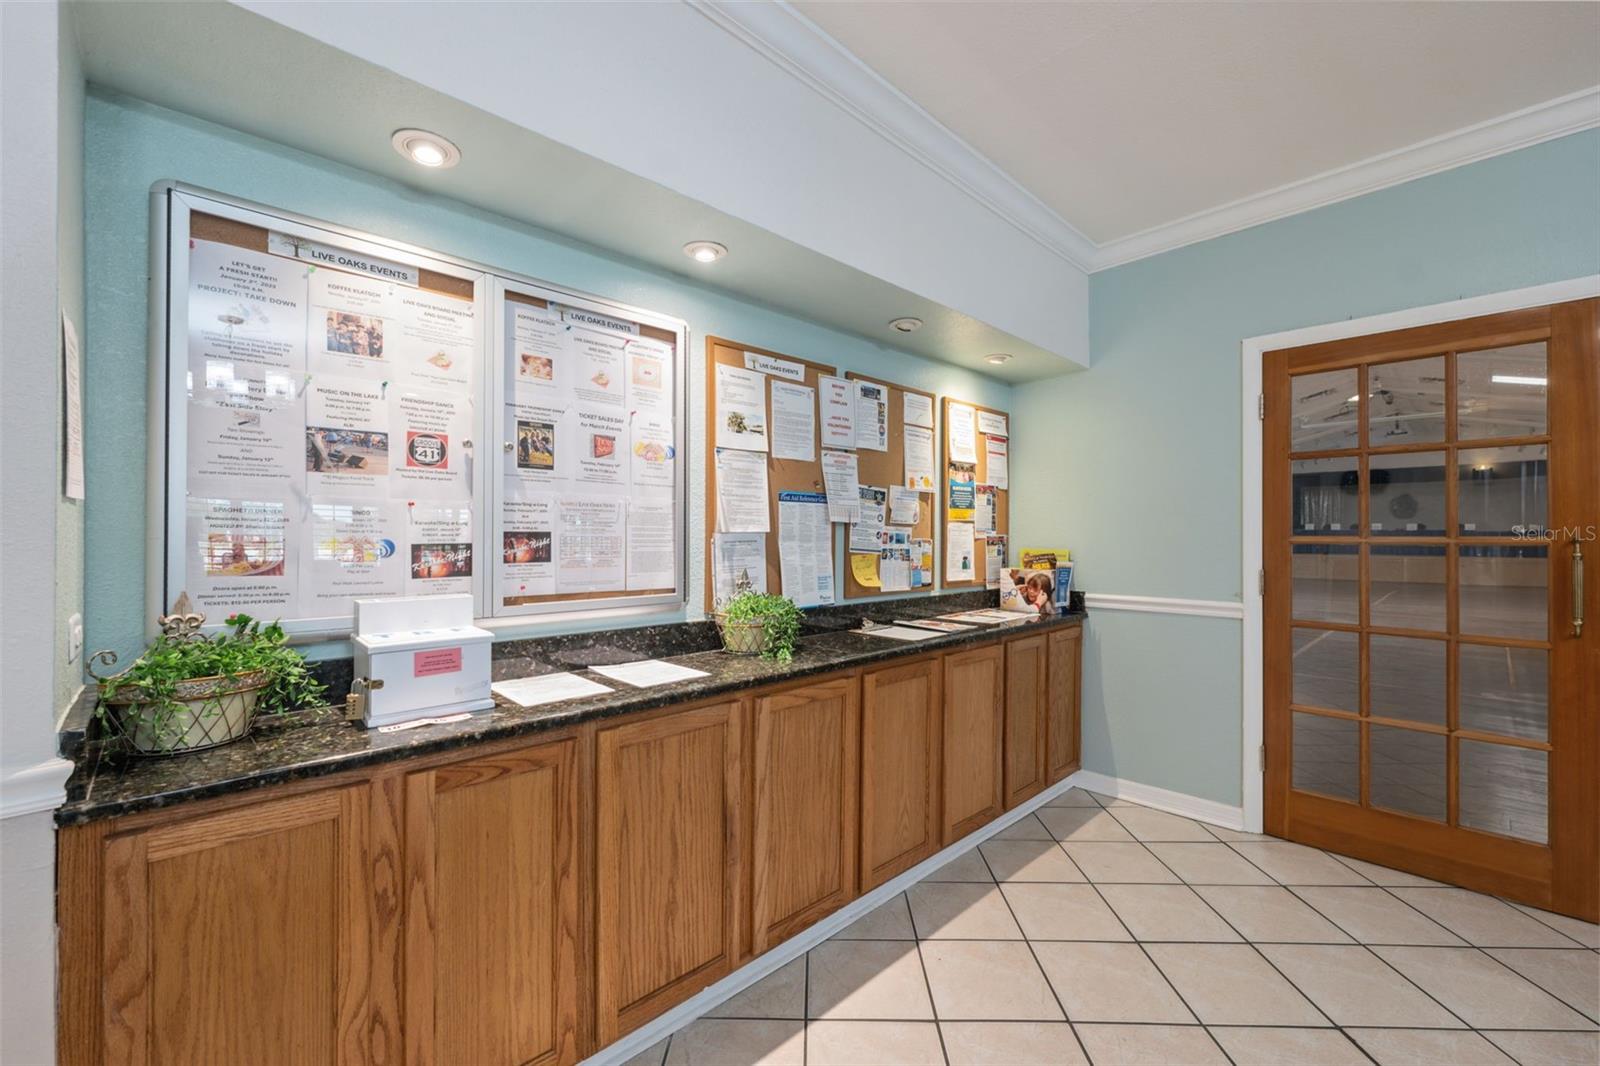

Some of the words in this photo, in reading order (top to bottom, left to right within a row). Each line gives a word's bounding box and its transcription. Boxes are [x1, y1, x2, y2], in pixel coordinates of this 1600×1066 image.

[231, 261, 251, 269] LET'S
[311, 250, 335, 263] LIVE
[338, 256, 368, 271] OAKS
[370, 264, 409, 281] EVENTS
[226, 268, 249, 276] FRESH
[220, 274, 247, 283] January
[327, 283, 352, 294] KOFFEE
[197, 283, 241, 297] PROJECT:
[245, 292, 266, 303] TAKE
[269, 297, 297, 307] DOWN
[571, 313, 587, 322] LIVE
[588, 316, 606, 327] OAKS
[607, 321, 632, 333] EVENTS
[782, 367, 799, 375] EVENTS
[317, 387, 338, 395] MUSIC
[401, 397, 434, 406] FRIENDSHIP
[598, 415, 614, 423] SALES
[415, 439, 439, 448] GROOVE
[419, 449, 435, 459] 41
